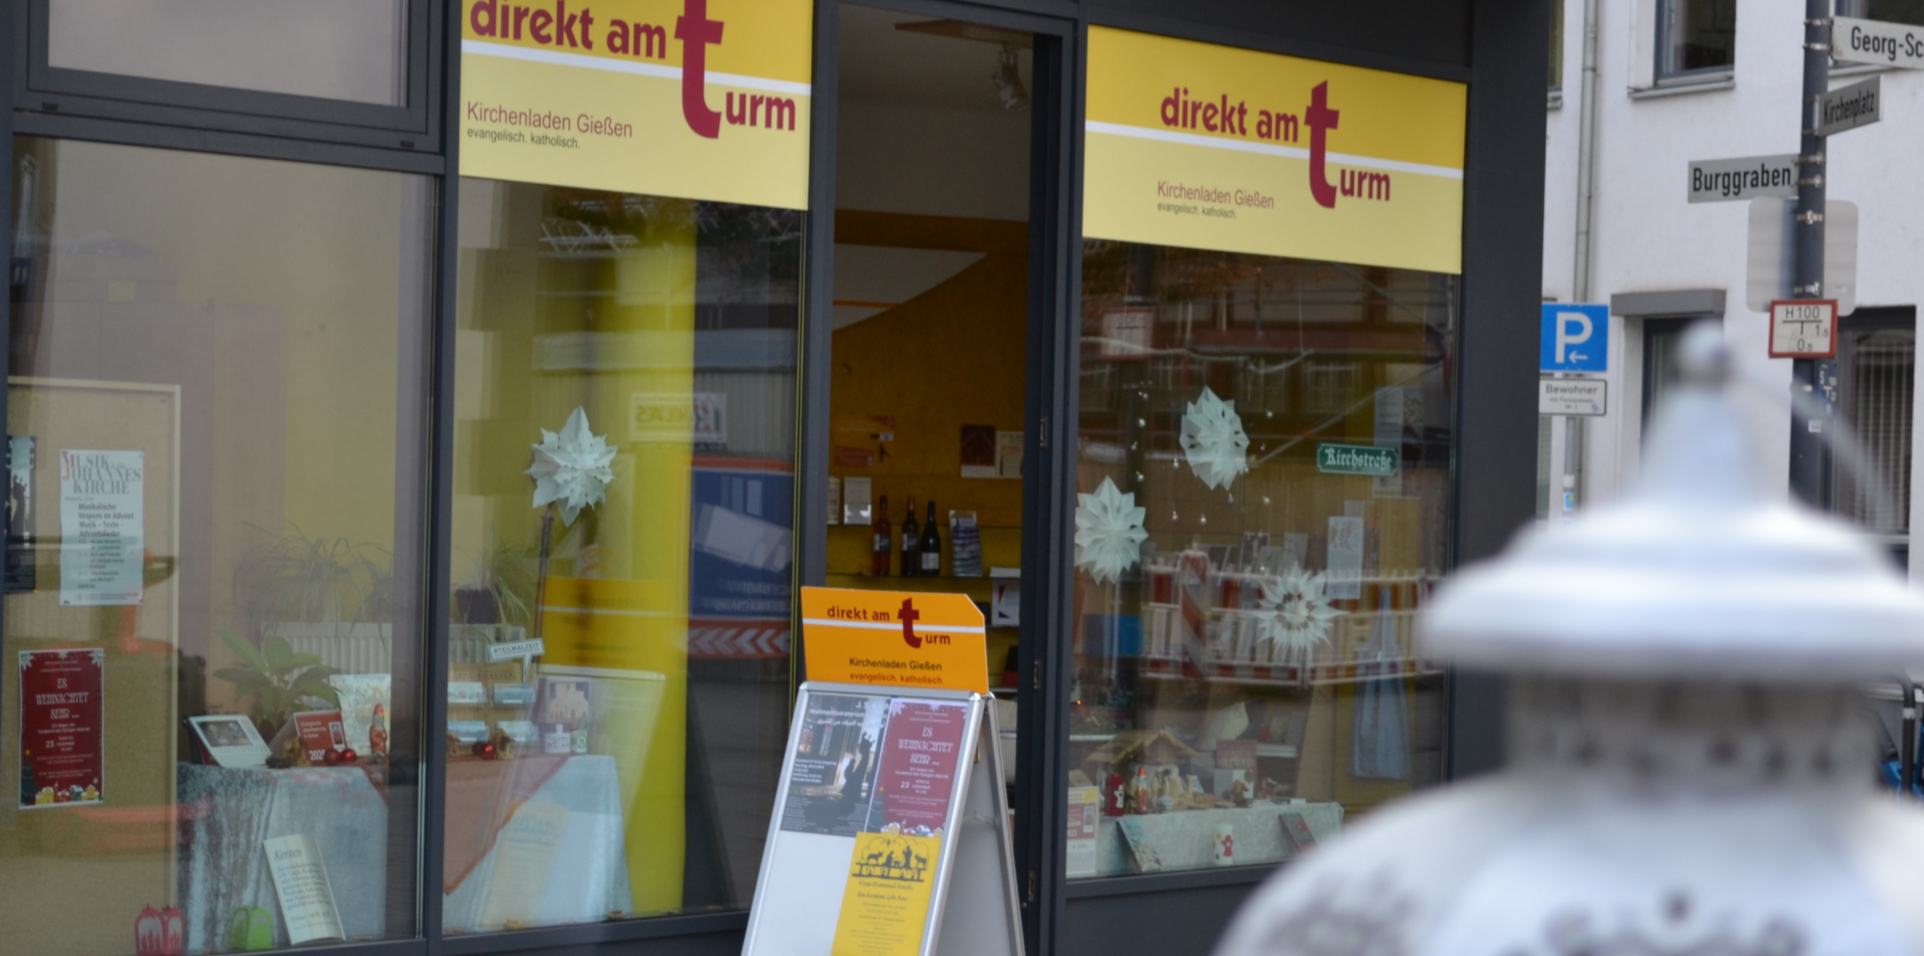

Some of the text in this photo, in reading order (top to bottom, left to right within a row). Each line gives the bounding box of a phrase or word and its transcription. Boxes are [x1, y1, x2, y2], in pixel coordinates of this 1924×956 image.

[470, 0, 594, 50] direkt
[606, 18, 666, 59] am
[467, 101, 633, 138] Kirchenladen Gießen
[1160, 86, 1248, 136] direkt
[1255, 108, 1298, 143] am
[1823, 90, 1875, 126] Kirchenplatz
[467, 128, 580, 149] evangelisch. katholisch.
[1692, 163, 1791, 197] Burggraben
[1157, 181, 1275, 209] Kirchenladen Gießen
[1157, 201, 1237, 219] evangelisch. katholisch.
[1555, 312, 1593, 363] P
[1545, 383, 1598, 395] Bewohner
[1325, 447, 1392, 472] Kirchstraße
[73, 480, 130, 494] KIRCHE
[827, 605, 868, 621] direkt
[872, 610, 890, 622] am
[849, 657, 942, 671] Kirchenladen Gießen
[900, 674, 943, 685] katholisch
[274, 849, 302, 861] Kerzen
